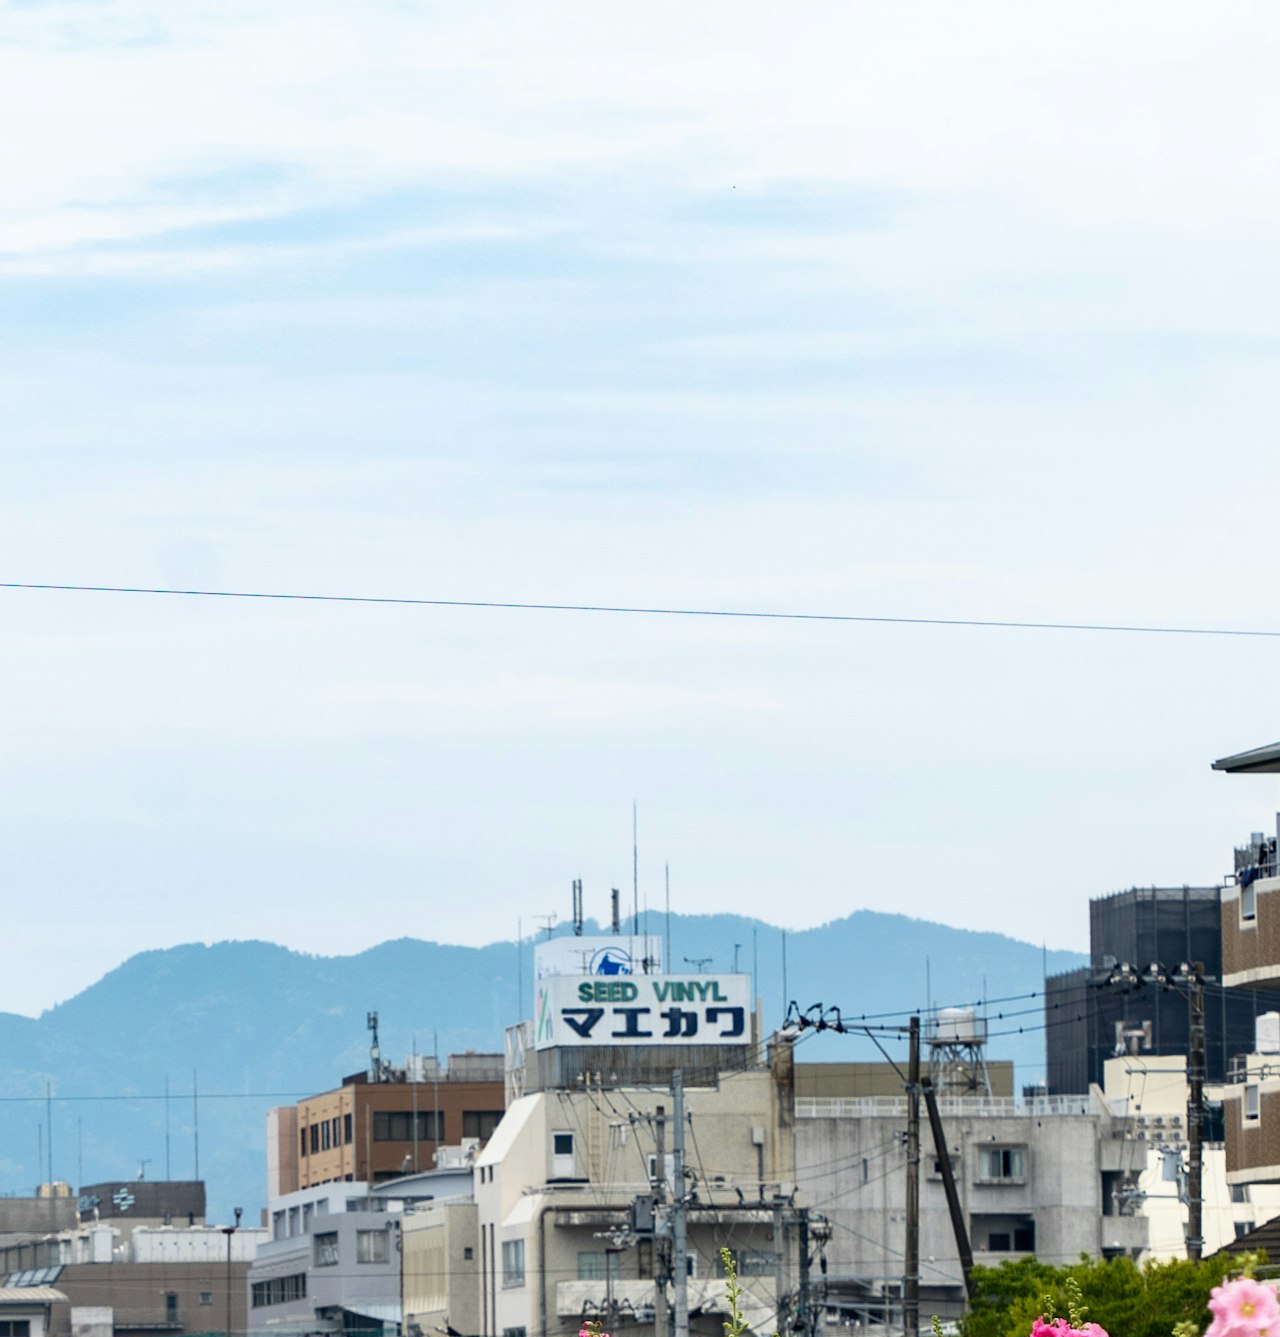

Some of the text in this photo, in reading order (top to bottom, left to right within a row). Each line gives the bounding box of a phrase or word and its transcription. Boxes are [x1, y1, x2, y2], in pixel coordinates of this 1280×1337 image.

[578, 981, 728, 1003] SEED VINYL
[561, 1007, 745, 1038] マエカワ
